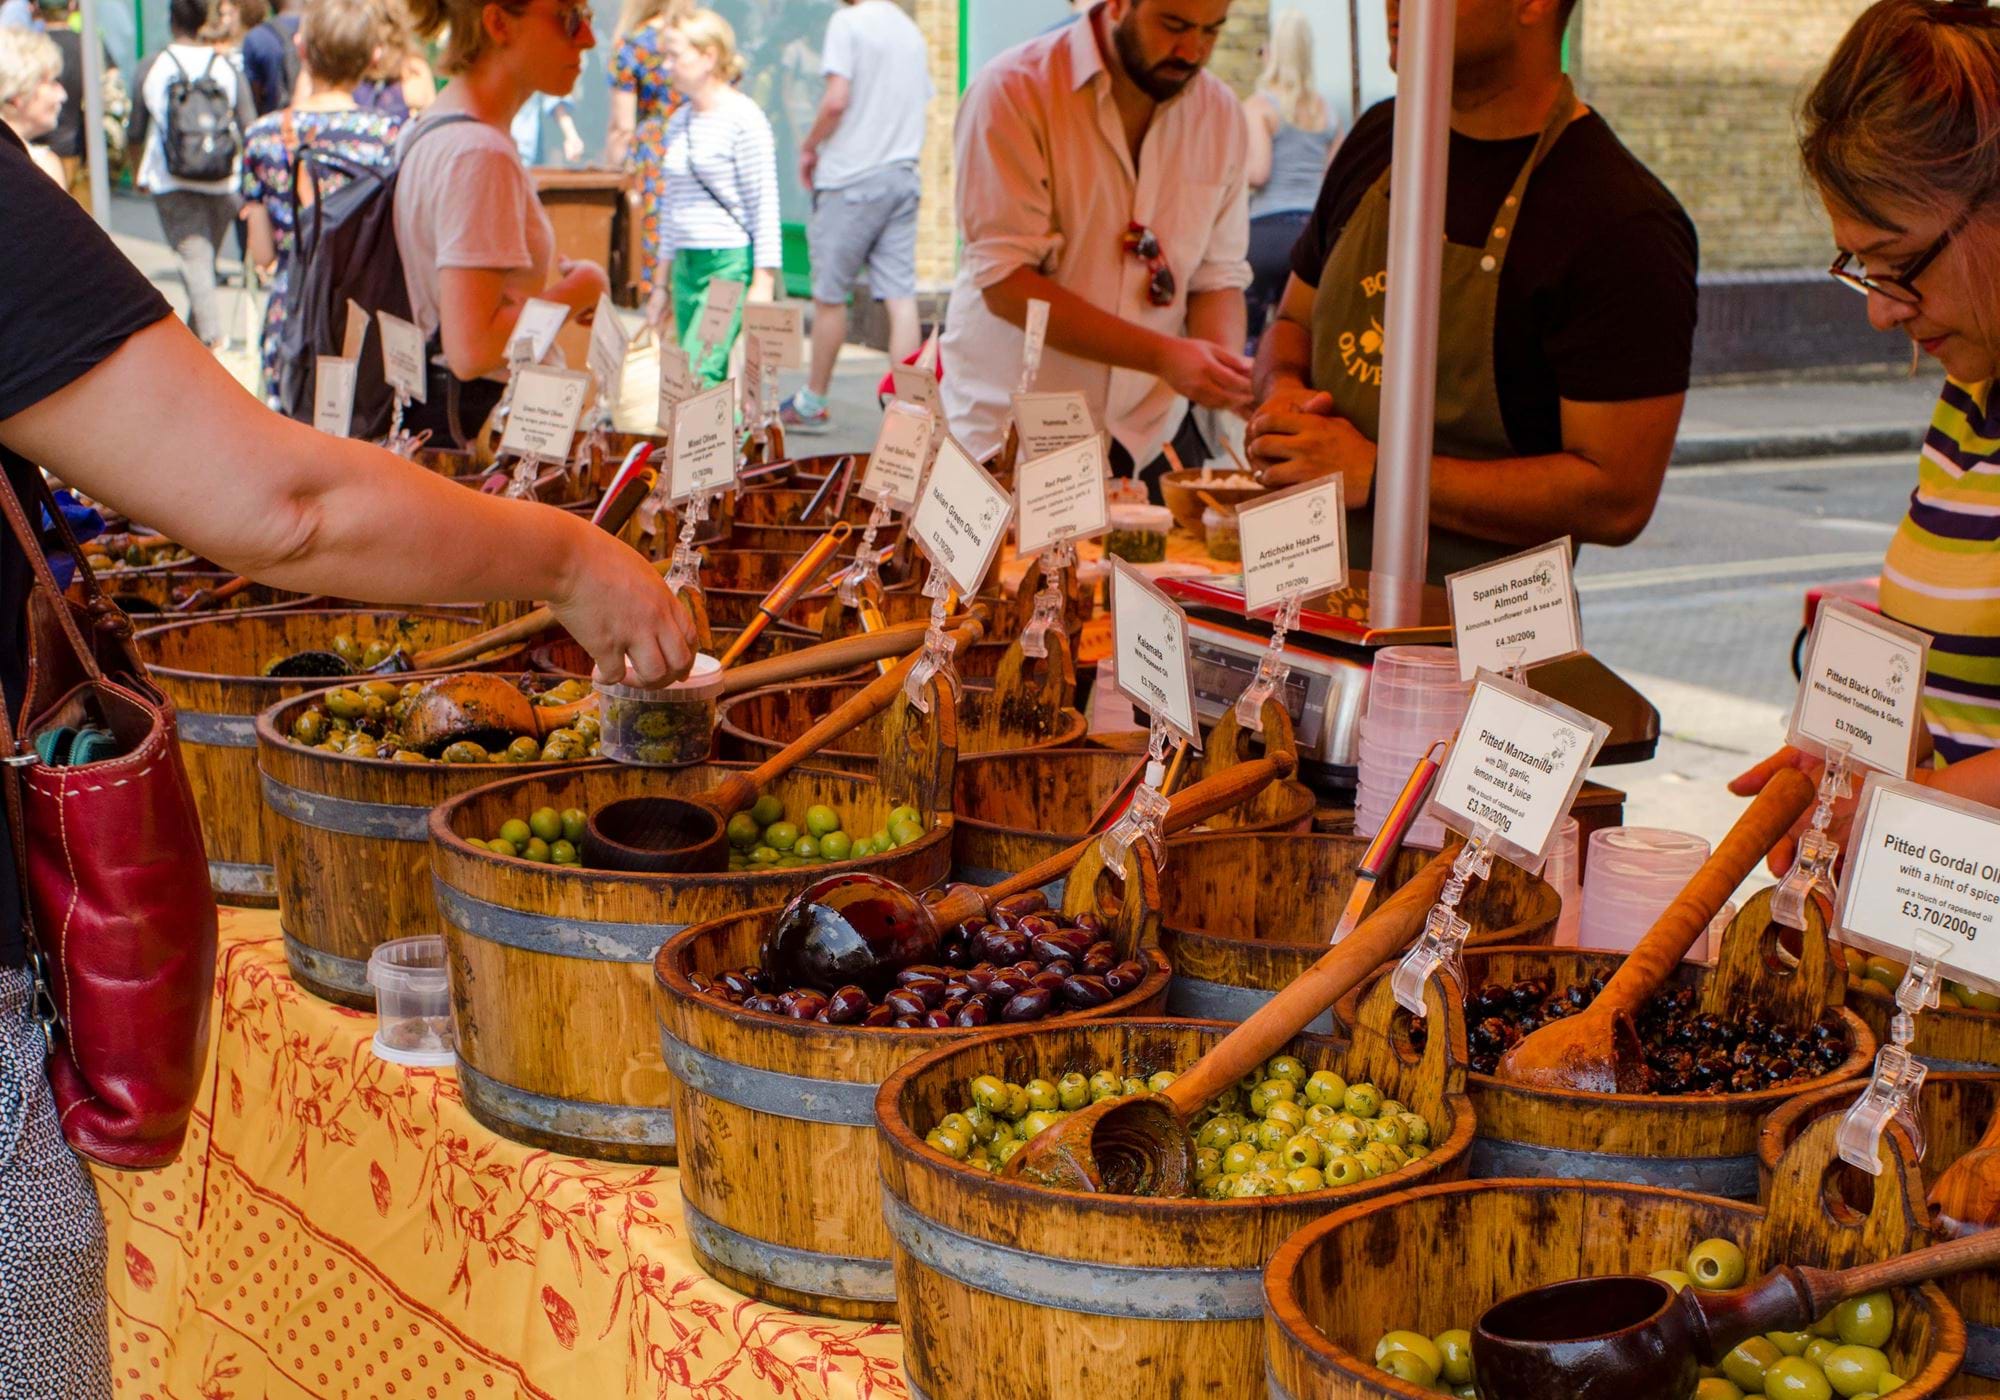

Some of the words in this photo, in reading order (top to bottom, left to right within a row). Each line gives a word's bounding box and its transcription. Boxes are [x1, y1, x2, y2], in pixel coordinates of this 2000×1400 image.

[1360, 271, 1388, 298] BO
[1339, 331, 1383, 386] OLIVE
[933, 486, 949, 510] Italian
[948, 504, 965, 528] Green
[963, 522, 981, 547] Olives
[1259, 543, 1295, 560] Artichoke
[1295, 534, 1321, 549] Hearts
[1472, 582, 1509, 602] Spanish
[1510, 569, 1547, 590] Roasted
[1494, 590, 1529, 610] Almond
[1493, 609, 1523, 624] sunflower
[1523, 606, 1532, 615] oil
[1533, 604, 1538, 612] &
[1538, 601, 1550, 610] sea
[1551, 597, 1563, 607] salt
[1137, 632, 1163, 661] Kalamata
[1826, 668, 1848, 686] Pitted
[1848, 678, 1871, 696] Black
[1871, 688, 1896, 707] Olives
[1827, 687, 1852, 705] Sundried
[1852, 698, 1880, 717] Tomatoes
[1880, 711, 1886, 719] &
[1886, 713, 1904, 728] Garlic
[1835, 718, 1872, 745] £3.70/200g
[1479, 729, 1506, 751] Pitted
[1504, 741, 1554, 774] Manzanilla
[1473, 765, 1493, 783] lemon
[1492, 777, 1508, 790] zest
[1507, 782, 1514, 793] &
[1512, 785, 1532, 802] juice
[1508, 767, 1530, 784] garlic,
[1466, 797, 1512, 833] £3.70/200g
[1884, 833, 1926, 859] Pitted
[1929, 848, 1978, 876] Gordal
[1981, 865, 2000, 884] Oli
[1899, 864, 1922, 879] with
[1923, 872, 1931, 882] a
[1932, 873, 1955, 890] hint
[1956, 882, 1970, 893] of
[1969, 886, 2000, 904] spice
[1896, 886, 1910, 896] and
[1917, 892, 1938, 905] touch
[1938, 899, 1948, 908] of
[1947, 902, 1982, 919] rapeseed
[1982, 914, 1993, 923] oil
[1901, 901, 1978, 941] £3.70/200g
